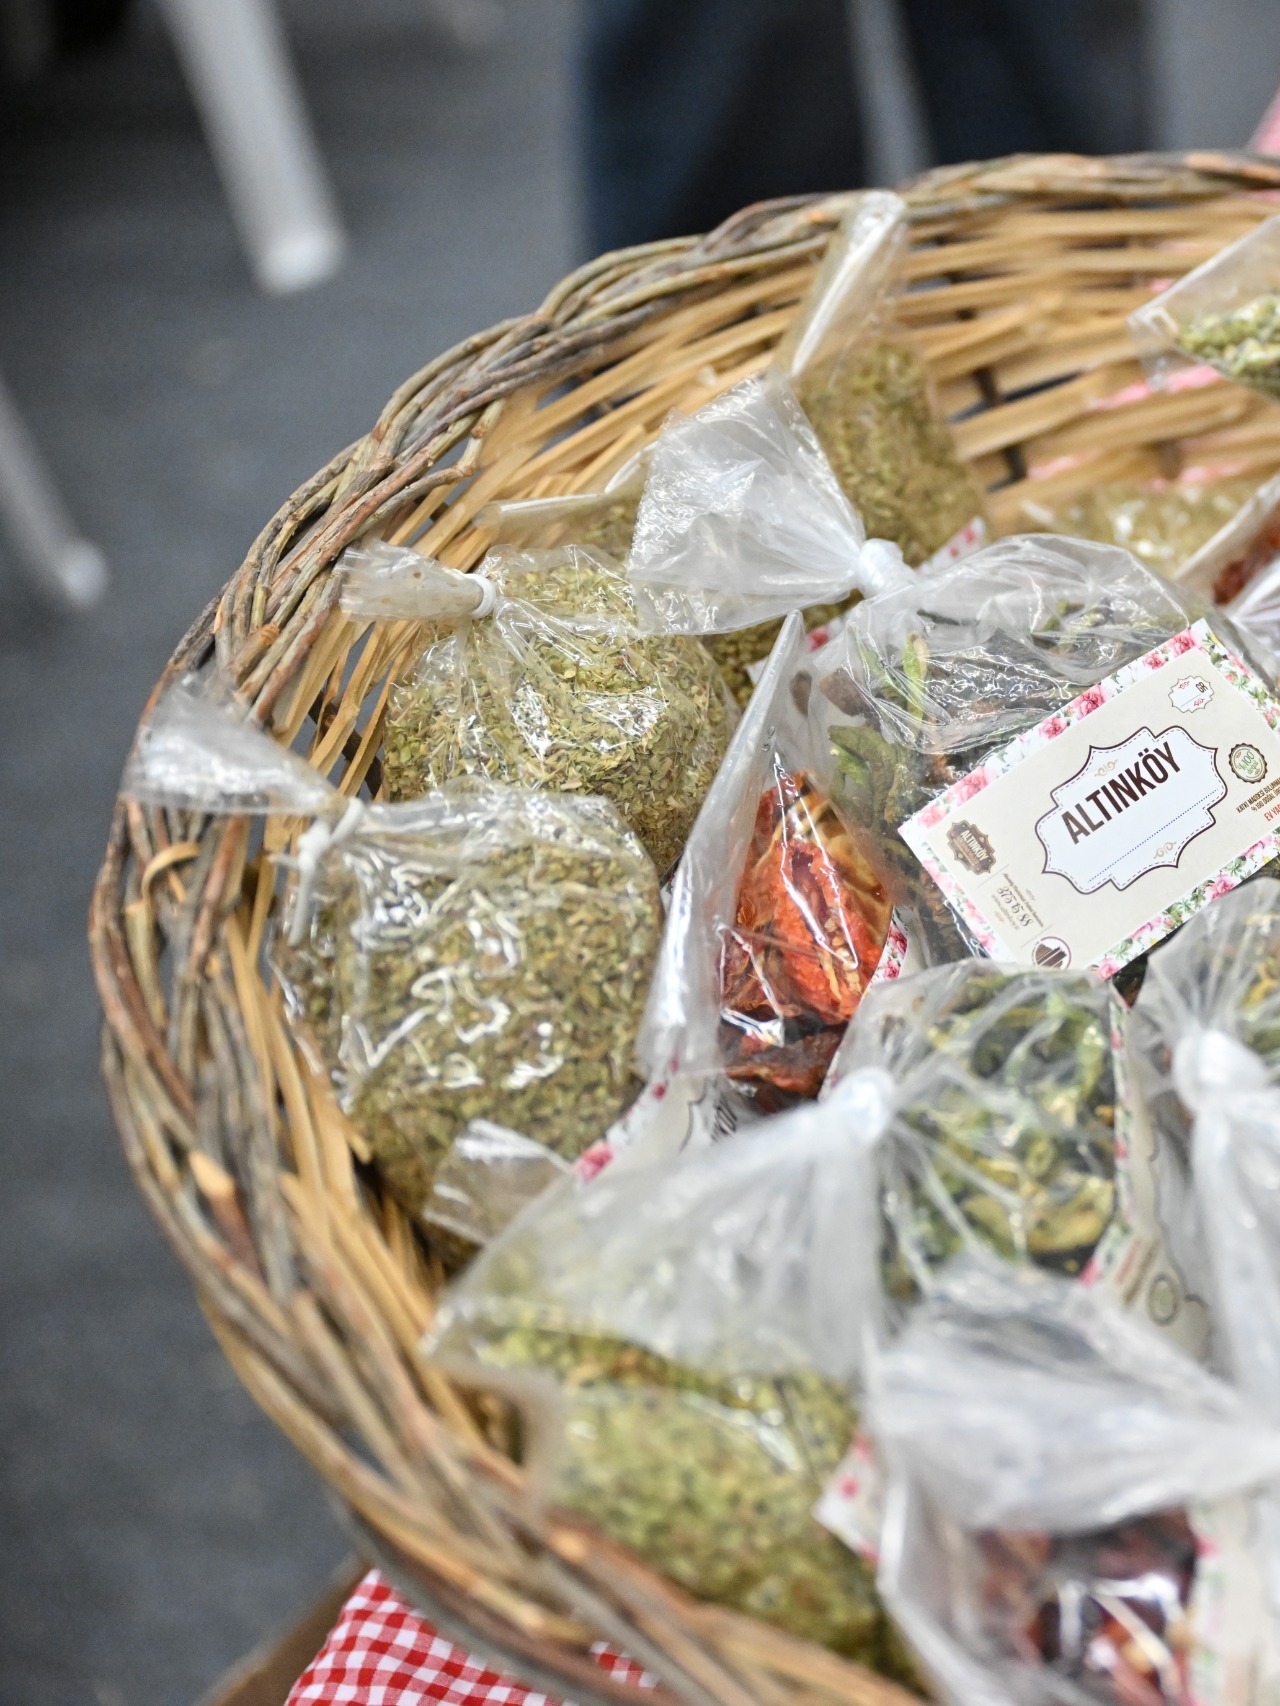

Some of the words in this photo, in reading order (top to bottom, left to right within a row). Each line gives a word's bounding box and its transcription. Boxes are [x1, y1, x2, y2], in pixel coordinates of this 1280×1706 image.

[1061, 741, 1181, 844] ALTINKÖY
[1264, 811, 1273, 821] EV
[961, 829, 989, 861] ALTINKÖY
